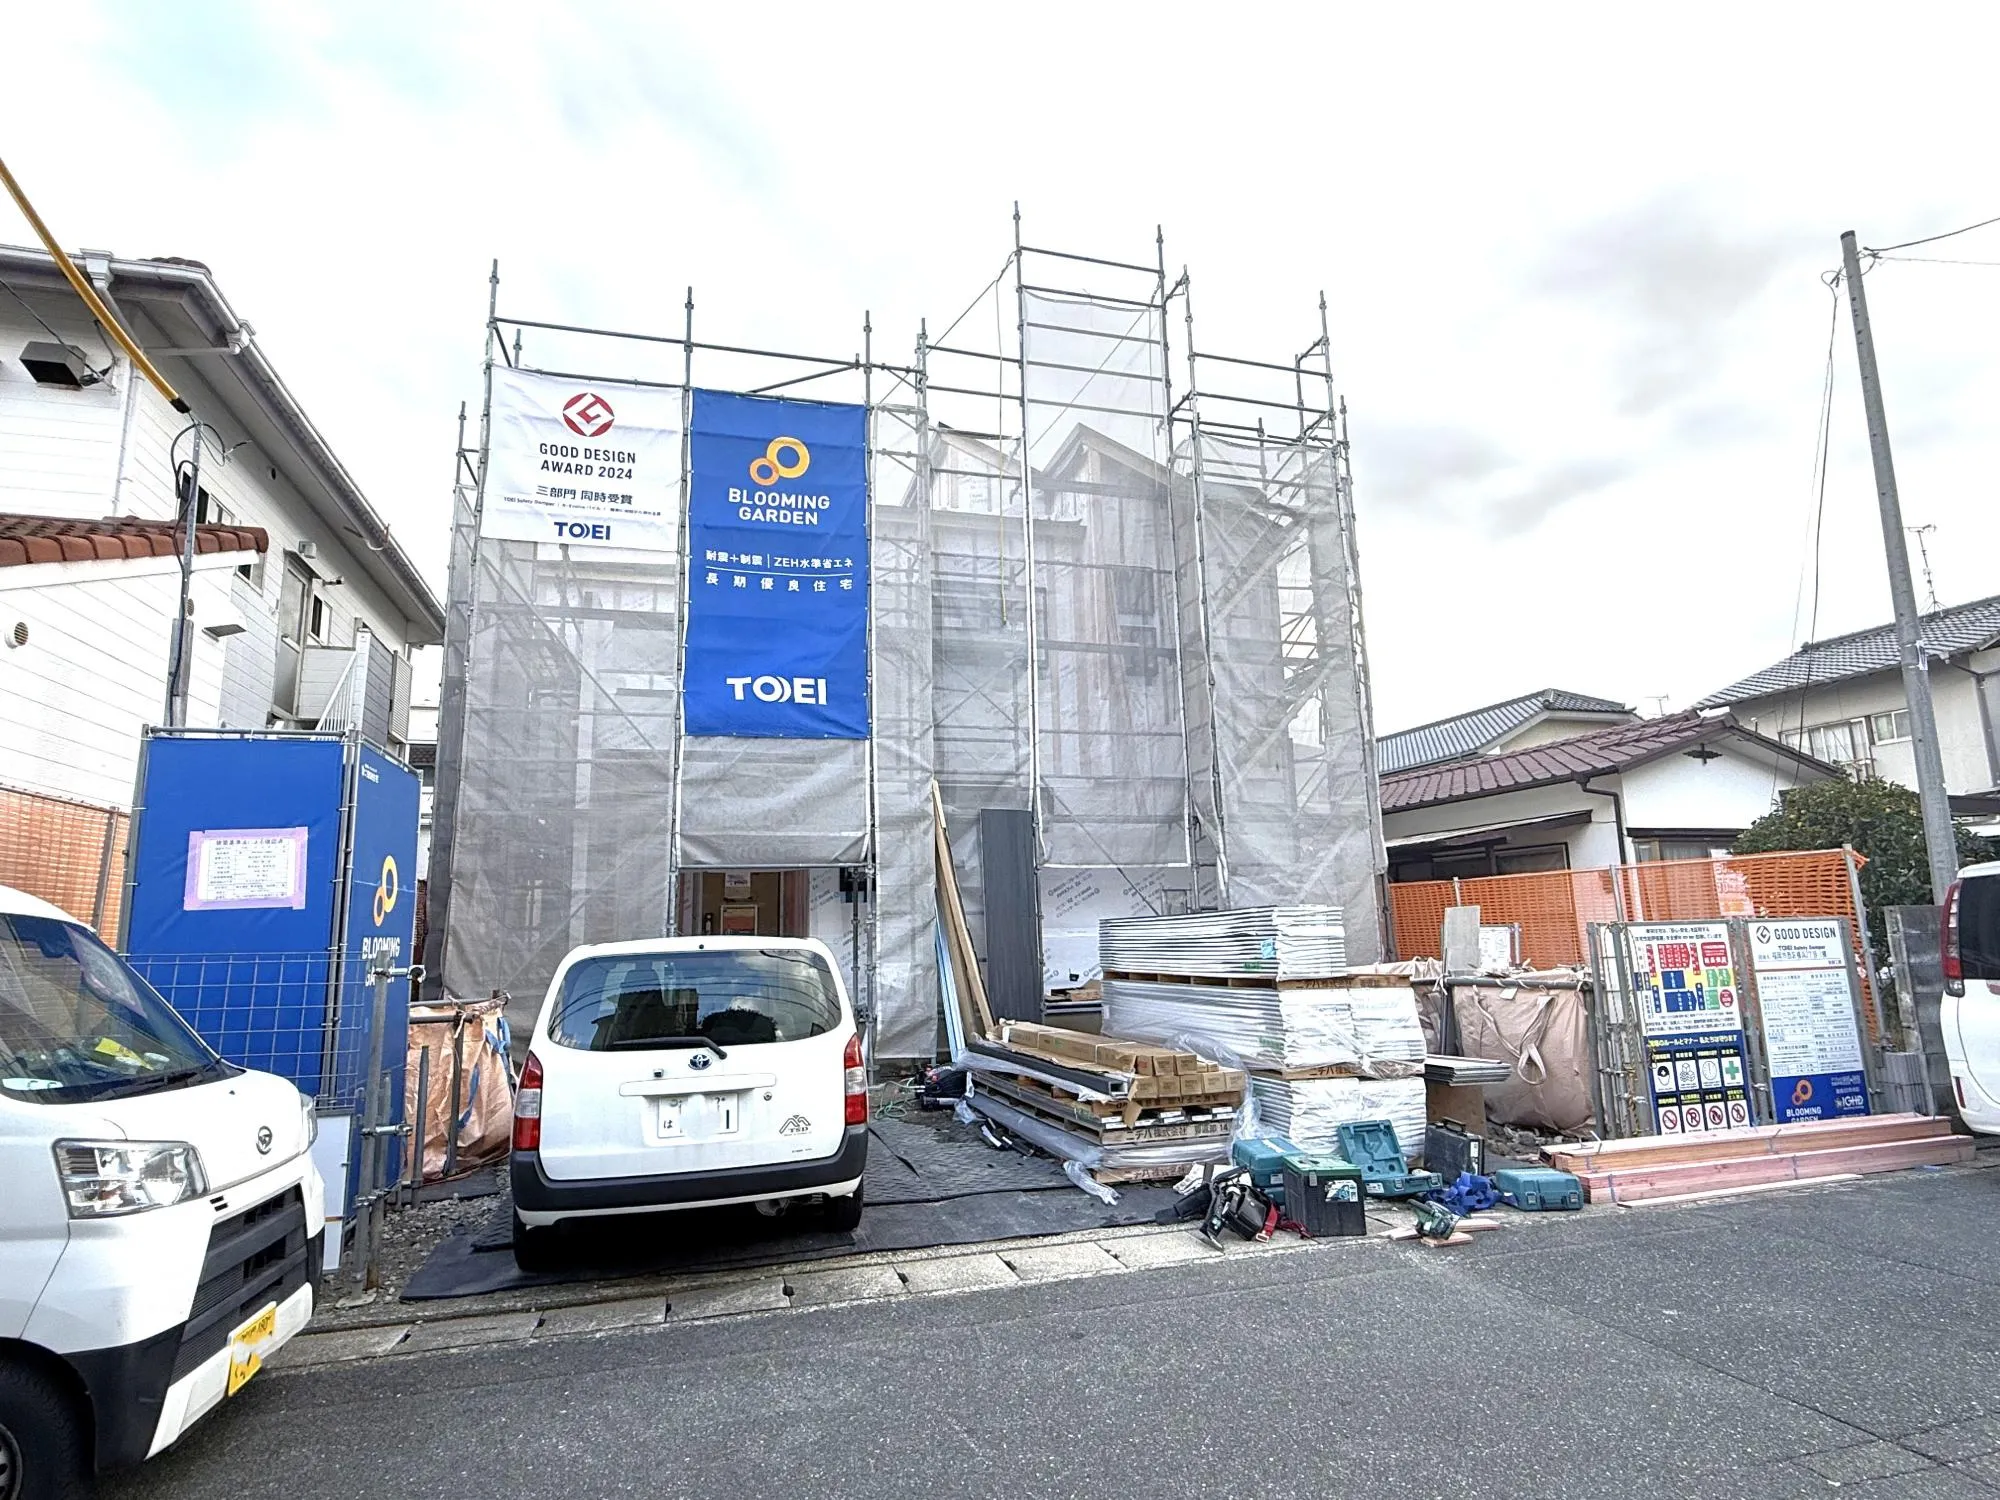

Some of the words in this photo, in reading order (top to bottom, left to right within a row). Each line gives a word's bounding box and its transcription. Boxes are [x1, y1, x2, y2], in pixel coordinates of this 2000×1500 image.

[540, 443, 579, 459] GOOD
[584, 448, 636, 464] DESIGN
[541, 459, 594, 476] AWARD
[598, 466, 633, 480] 2024
[536, 485, 576, 500] 三部門
[580, 490, 633, 505] 同時受賞
[728, 487, 831, 510] BLOOMING
[739, 507, 819, 526] GARDEN
[554, 521, 611, 540] TOEI
[705, 572, 853, 592] 長期優良住宅
[726, 675, 827, 706] TOEI
[1774, 928, 1800, 940] GOOD
[1803, 927, 1837, 939] DESIGN
[362, 936, 400, 960] BLOOMING
[1786, 1106, 1822, 1117] BLOOMING
[663, 1119, 673, 1129] は
